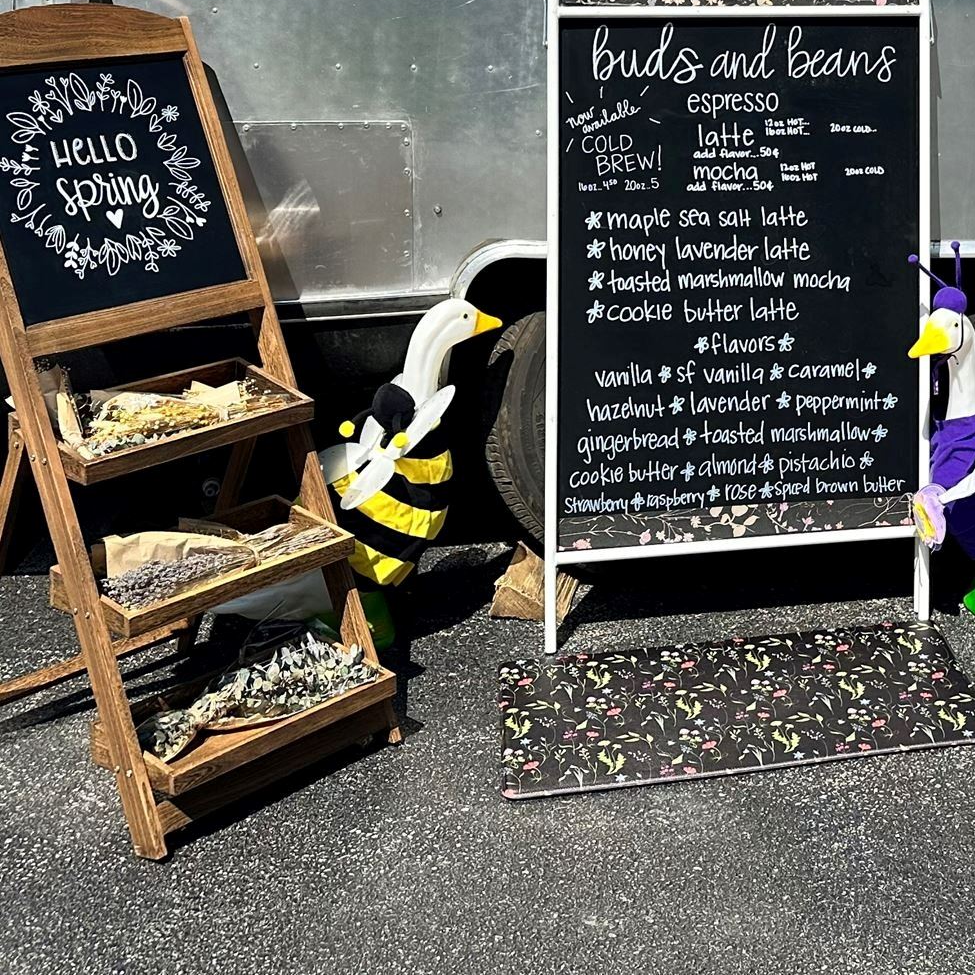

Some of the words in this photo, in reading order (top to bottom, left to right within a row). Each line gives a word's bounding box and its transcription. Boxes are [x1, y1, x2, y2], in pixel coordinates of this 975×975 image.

[592, 21, 703, 85] buds
[709, 22, 776, 80] and
[787, 24, 898, 83] beans
[565, 106, 595, 129] now
[582, 99, 641, 134] available
[687, 92, 779, 119] espresso
[698, 122, 755, 147] latte
[765, 119, 785, 127] 12oz
[765, 127, 787, 136] 16oz
[830, 123, 852, 133] 20oz
[582, 134, 633, 154] COLD
[693, 148, 717, 159] add
[595, 144, 662, 176] BREW!
[693, 162, 759, 181] mocha
[780, 163, 799, 172] 12oz
[800, 162, 816, 171] HOT
[845, 167, 864, 176] 20oz
[864, 166, 885, 175] COLD
[686, 181, 707, 192] add
[801, 173, 819, 182] HOT
[55, 172, 160, 222] spring
[606, 206, 671, 236] maple
[678, 207, 710, 228] sea
[718, 208, 752, 229] salt
[761, 205, 809, 227] latte
[609, 236, 667, 270] honey
[675, 234, 759, 262] lavender
[764, 236, 811, 262] latte
[607, 269, 672, 294] toasted
[677, 266, 785, 291] marshmallow
[793, 270, 851, 293] mocha
[606, 299, 673, 323] cookie
[684, 298, 743, 324] butter
[750, 298, 800, 322] latte
[711, 332, 776, 355] flavors
[594, 361, 652, 389] vanilla
[676, 360, 697, 385] sf
[703, 363, 764, 386] vanilla
[788, 359, 861, 380] caramel
[586, 394, 666, 422] hazelnut
[690, 391, 770, 415] lavender
[795, 392, 883, 416] peppermint
[577, 427, 680, 464] gingerbread
[699, 420, 765, 445] toasted
[770, 421, 871, 443] marshmallow
[568, 462, 624, 489] cookie
[629, 462, 679, 483] butter
[698, 453, 758, 477] almond
[779, 449, 856, 479] pistachio
[645, 489, 705, 511] raspberry
[724, 482, 757, 501] rose
[815, 478, 859, 494] brown
[863, 475, 906, 494] butter
